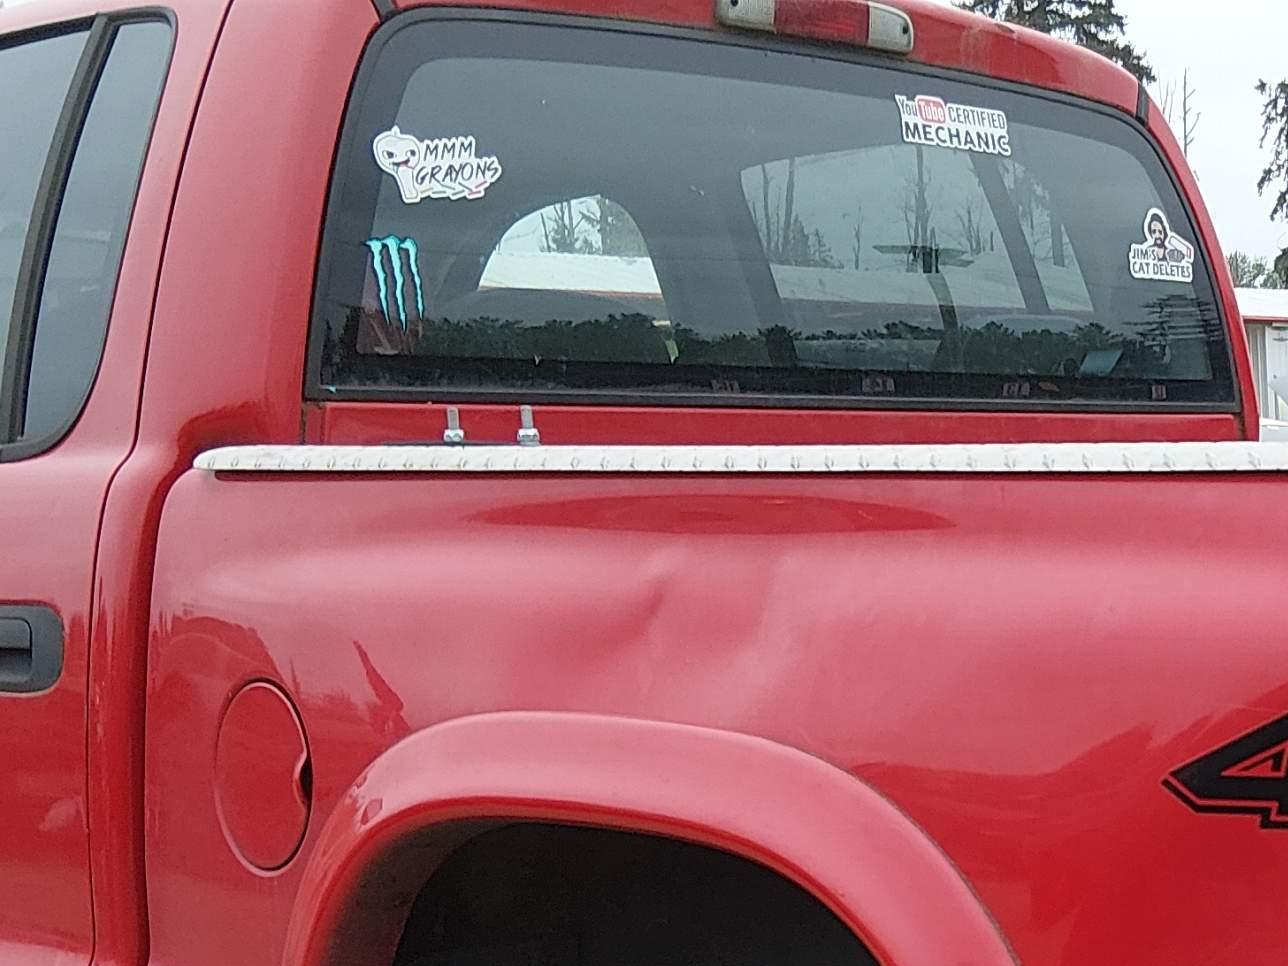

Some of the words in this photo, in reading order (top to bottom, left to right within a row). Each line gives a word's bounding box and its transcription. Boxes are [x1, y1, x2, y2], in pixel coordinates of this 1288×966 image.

[948, 106, 1005, 129] CERTIFIED
[905, 121, 1010, 153] MECHANIC
[424, 141, 473, 161] MMM
[1132, 261, 1150, 275] CAT
[1152, 263, 1191, 278] DELETES
